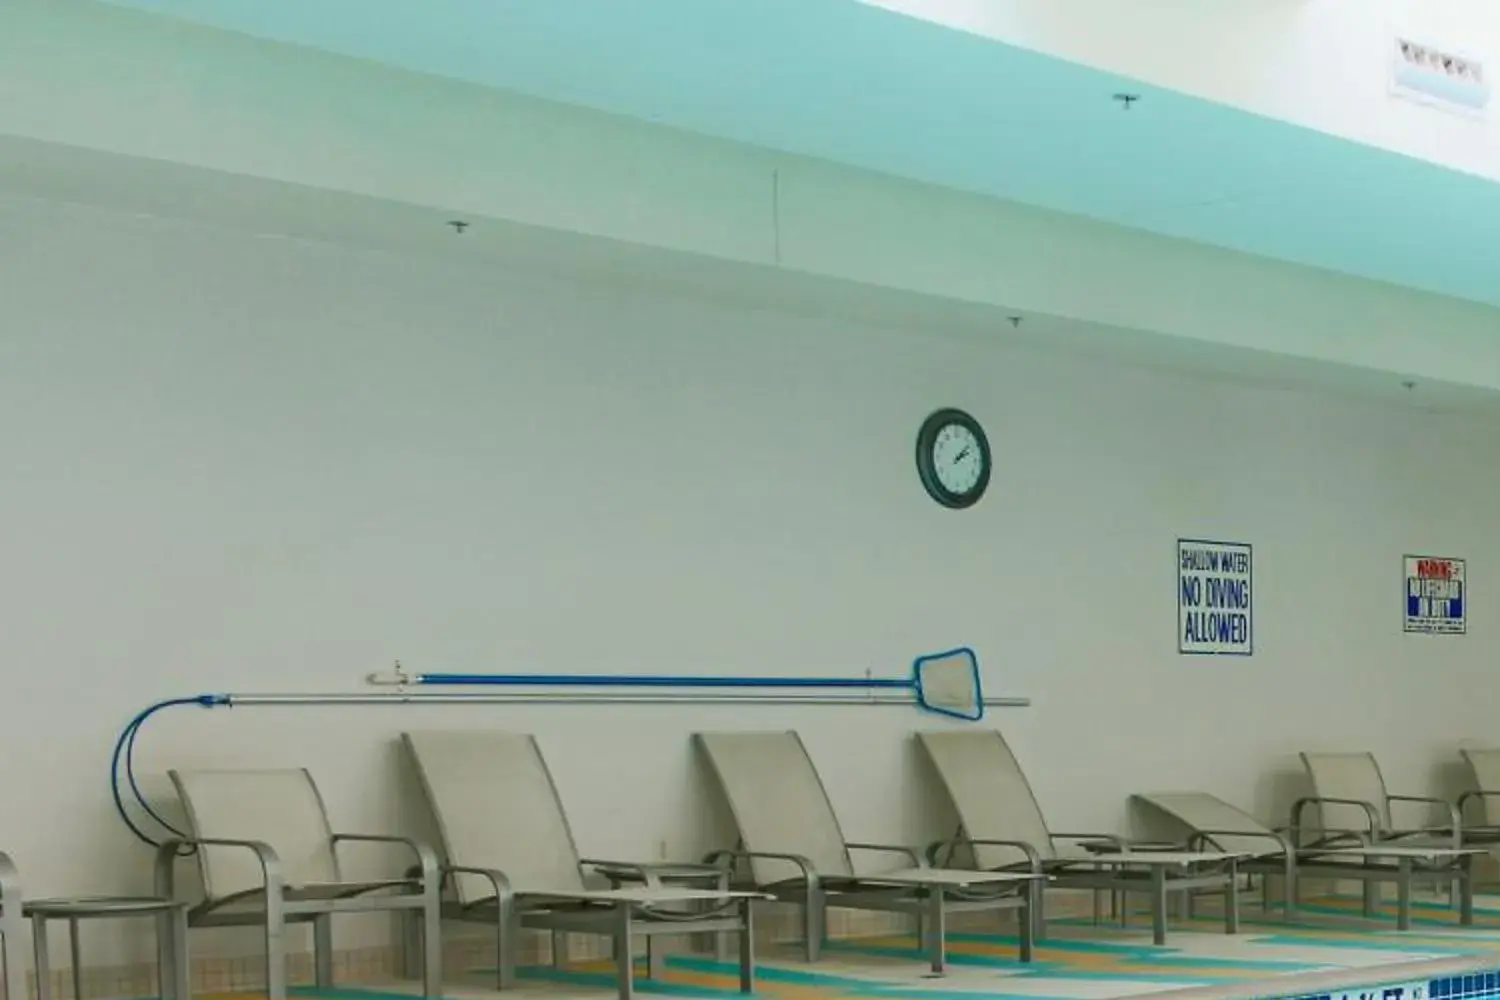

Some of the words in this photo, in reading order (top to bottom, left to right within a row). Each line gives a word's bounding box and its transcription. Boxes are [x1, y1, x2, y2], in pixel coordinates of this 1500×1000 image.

[1181, 549, 1219, 573] SHALLOW
[1221, 552, 1249, 574] WATER
[1181, 575, 1201, 607] NO
[1205, 577, 1249, 609] DIVING
[1184, 611, 1248, 644] ALLOWED
